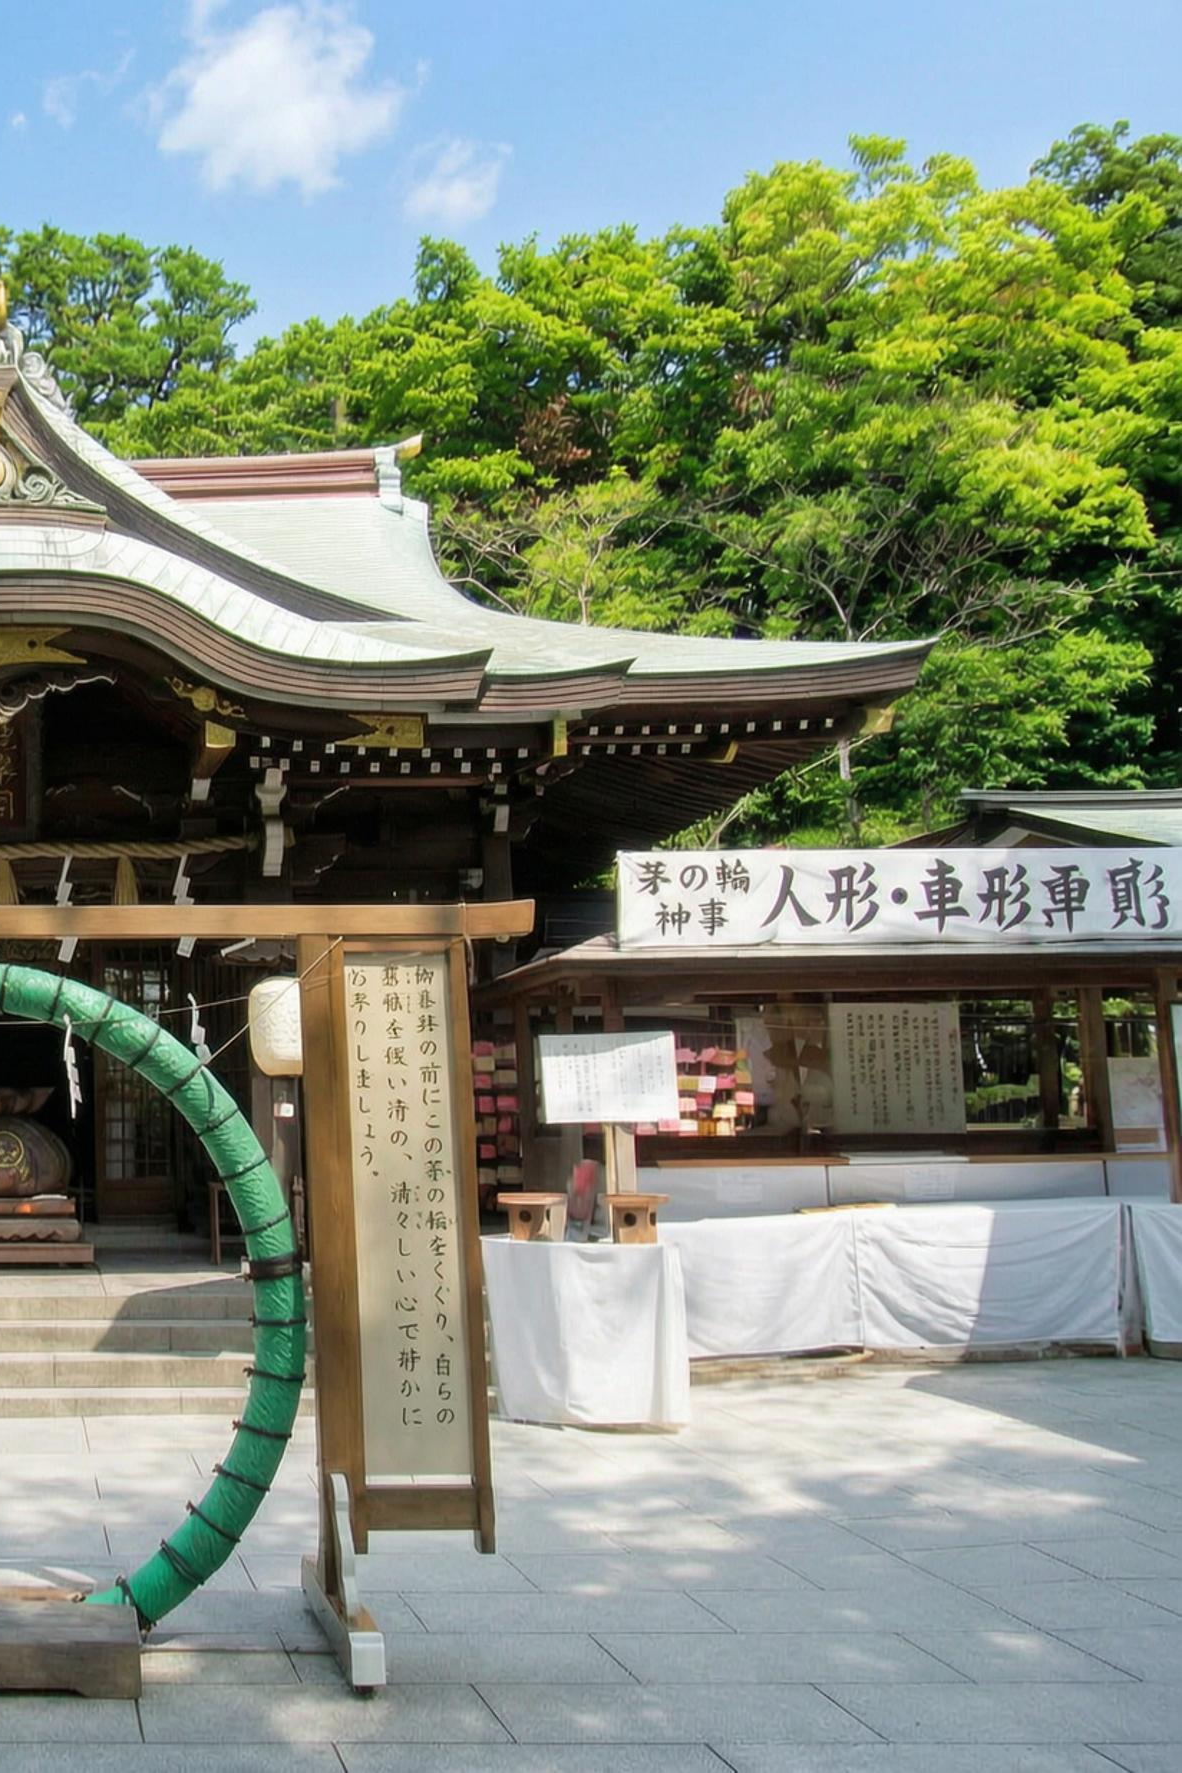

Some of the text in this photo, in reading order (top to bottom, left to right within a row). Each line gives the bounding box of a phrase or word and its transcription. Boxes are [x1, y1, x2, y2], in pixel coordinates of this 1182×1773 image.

[637, 858, 751, 896] 茅の輪
[655, 898, 729, 936] 神事
